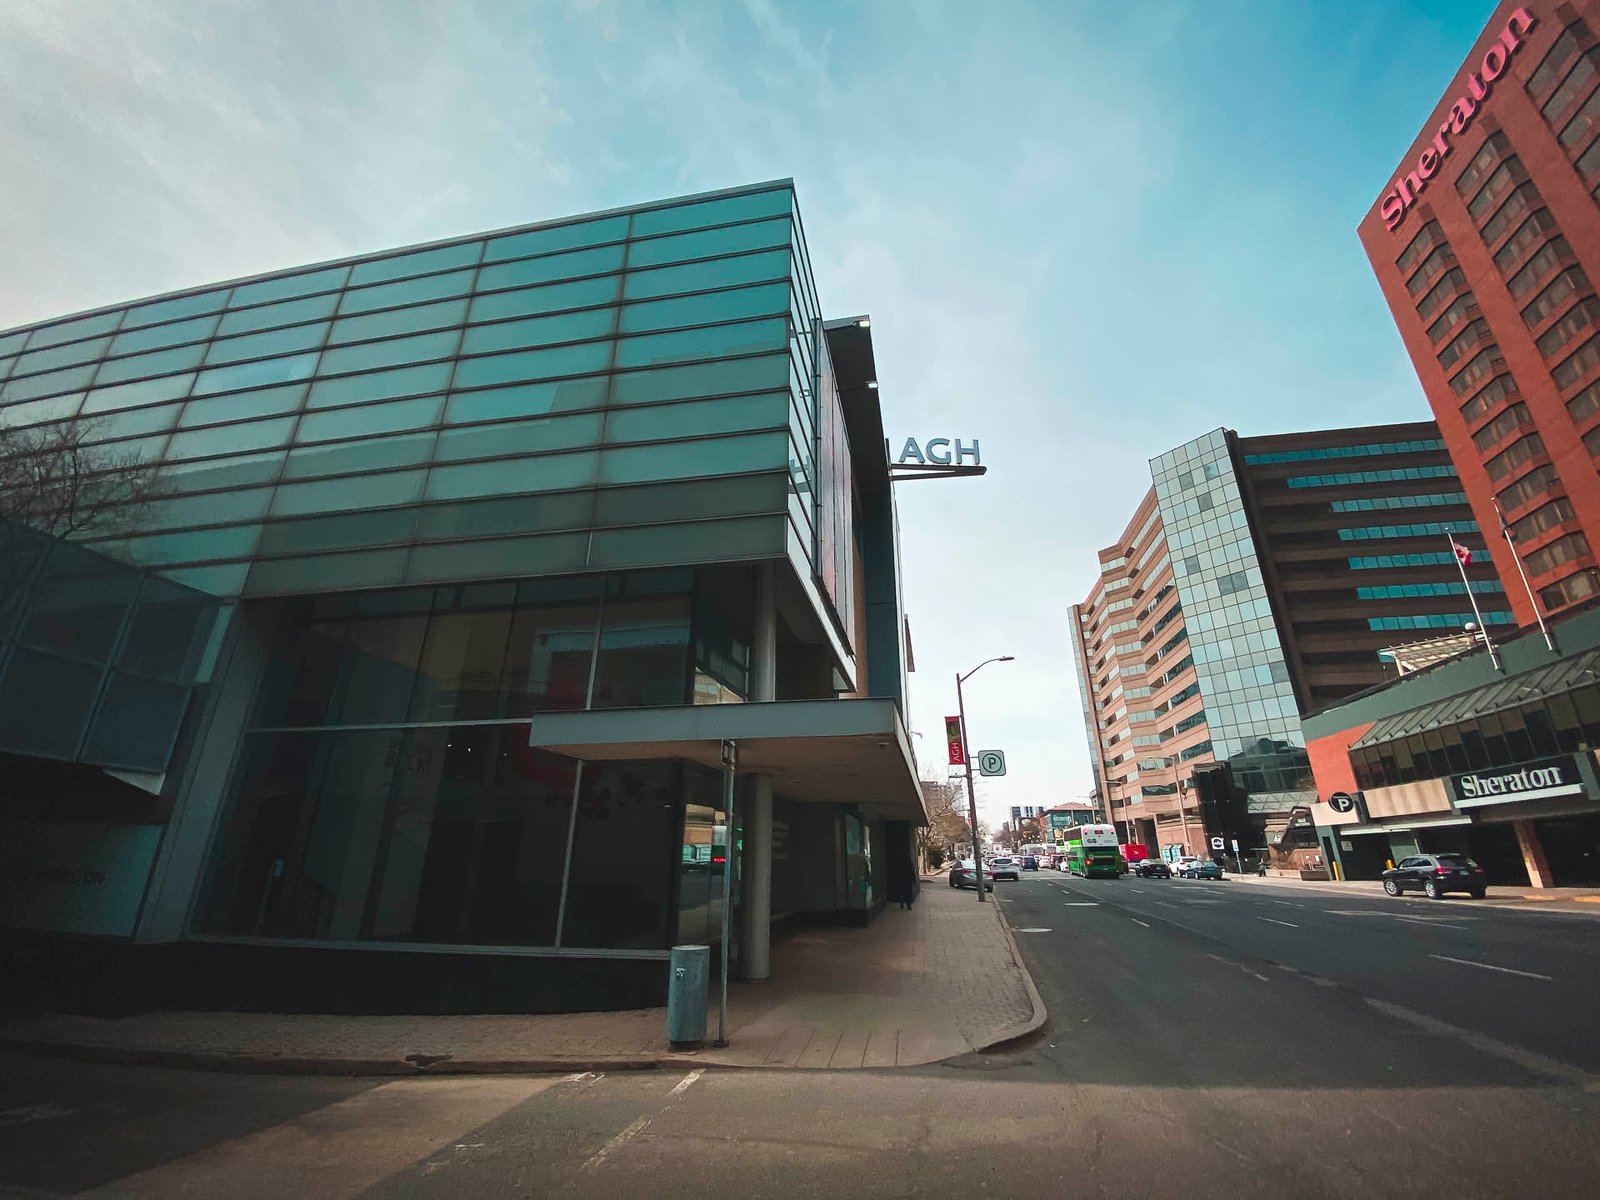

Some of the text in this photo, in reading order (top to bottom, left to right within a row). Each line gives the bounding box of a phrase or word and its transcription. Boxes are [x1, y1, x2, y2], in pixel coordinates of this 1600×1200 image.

[1380, 7, 1534, 232] Sheraton
[899, 437, 980, 465] AGH
[951, 742, 961, 762] AGH
[1460, 766, 1562, 797] Sheraton
[1337, 798, 1350, 811] P
